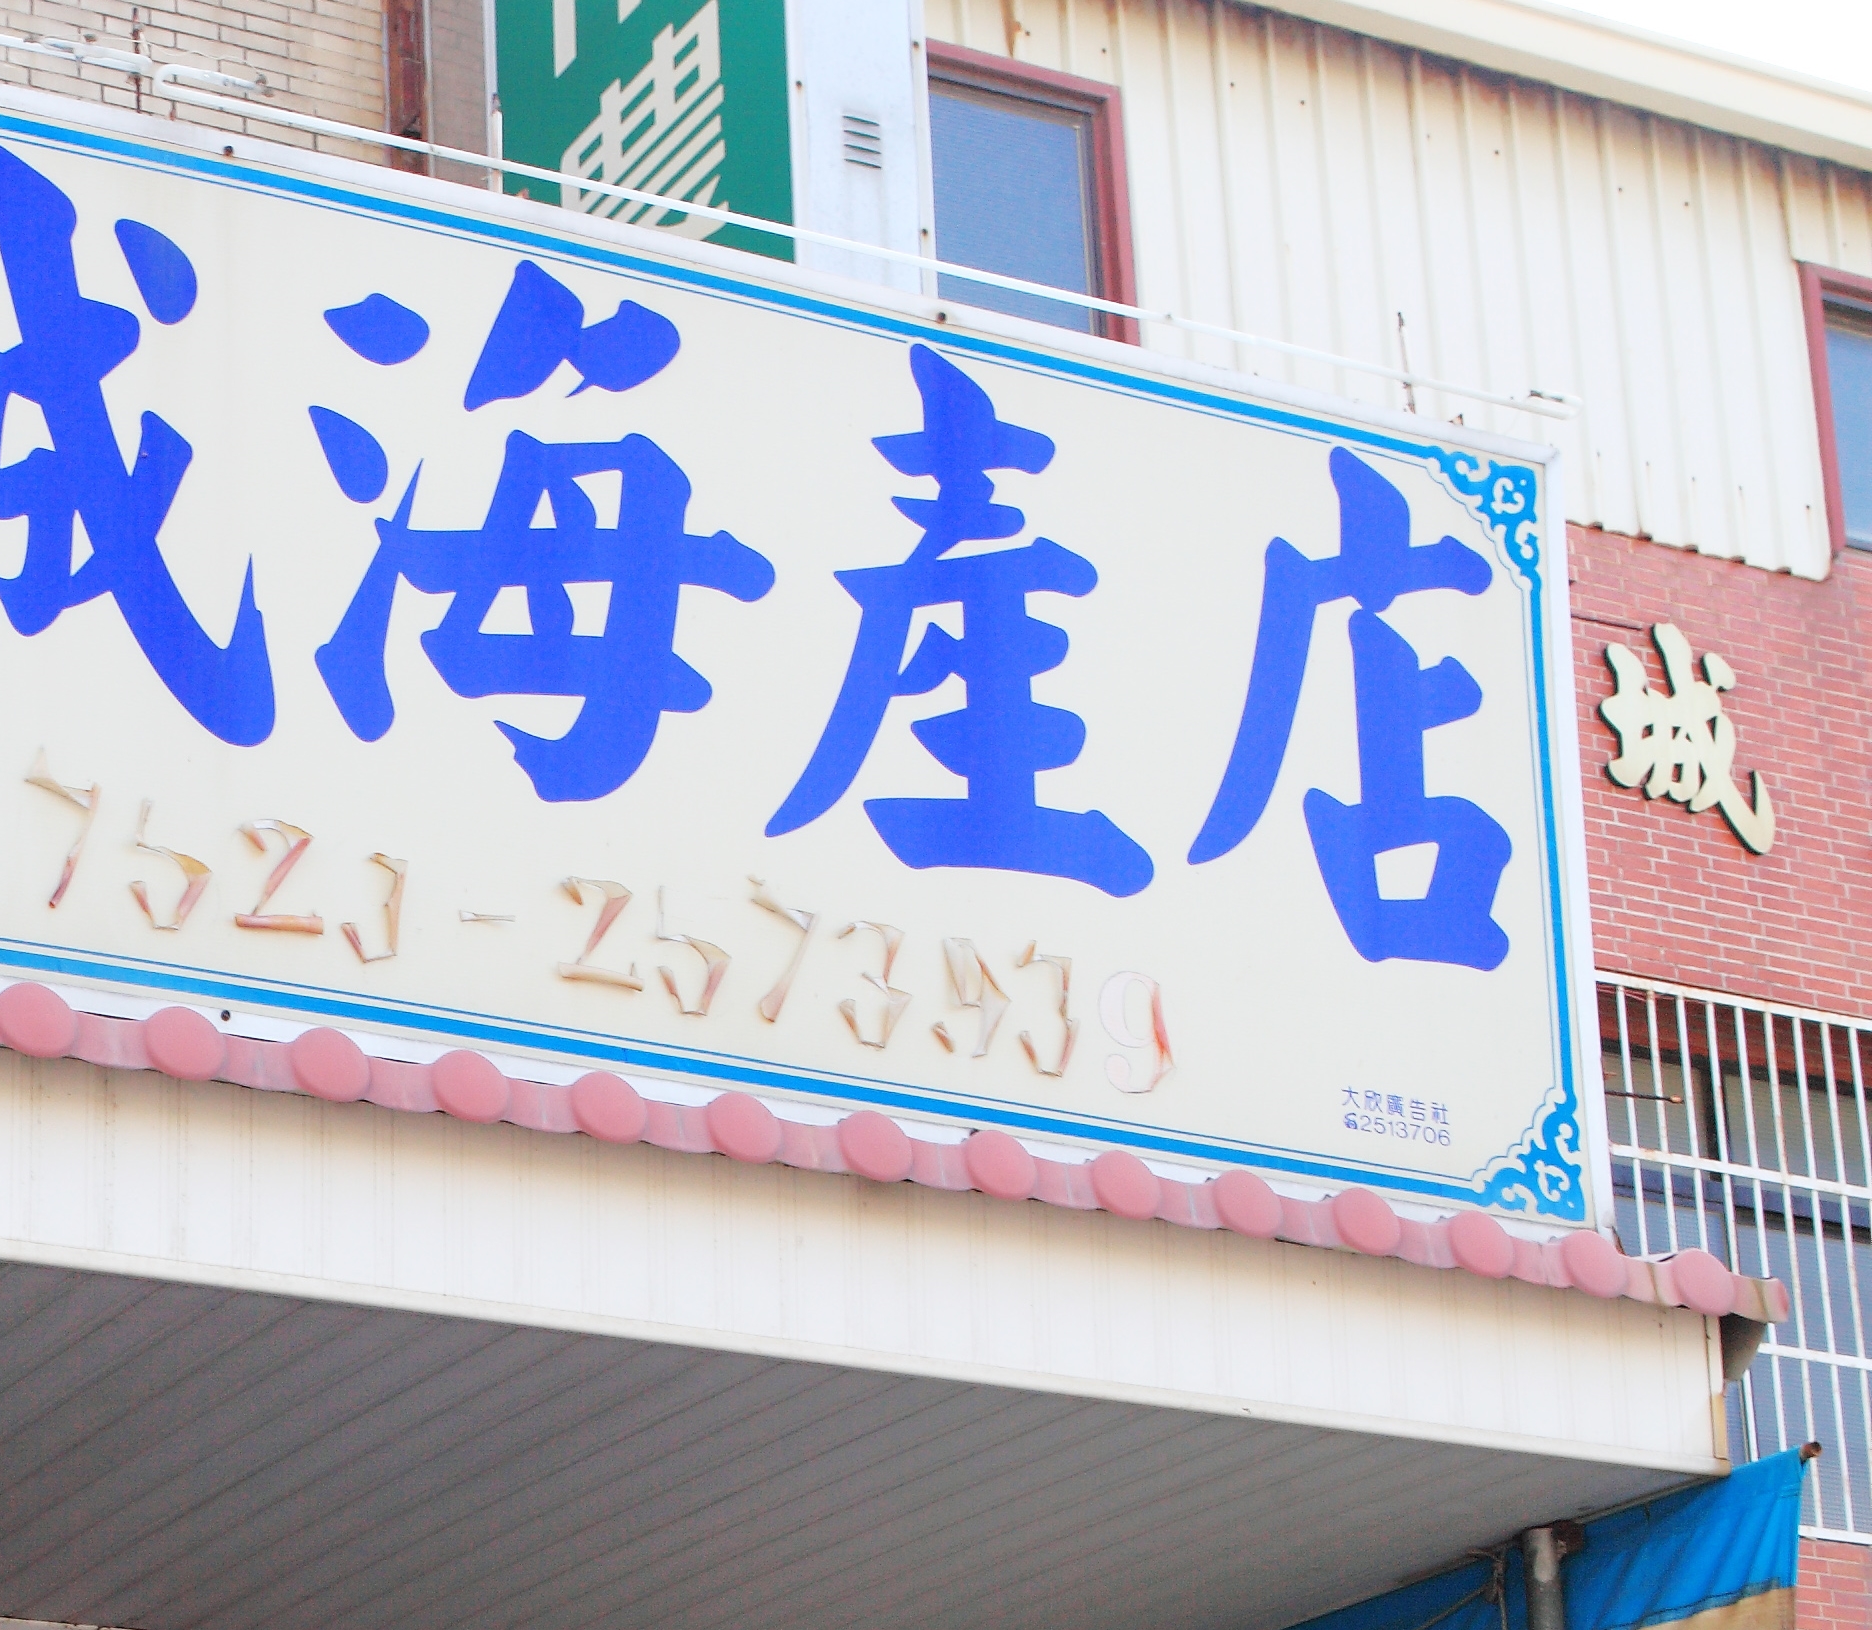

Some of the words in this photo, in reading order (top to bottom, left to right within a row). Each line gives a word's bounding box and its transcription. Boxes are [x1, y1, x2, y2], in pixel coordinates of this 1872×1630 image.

[1598, 622, 1776, 855] 城
[1341, 1086, 1450, 1125] 大欣廣告社
[1359, 1114, 1451, 1147] 2513706
